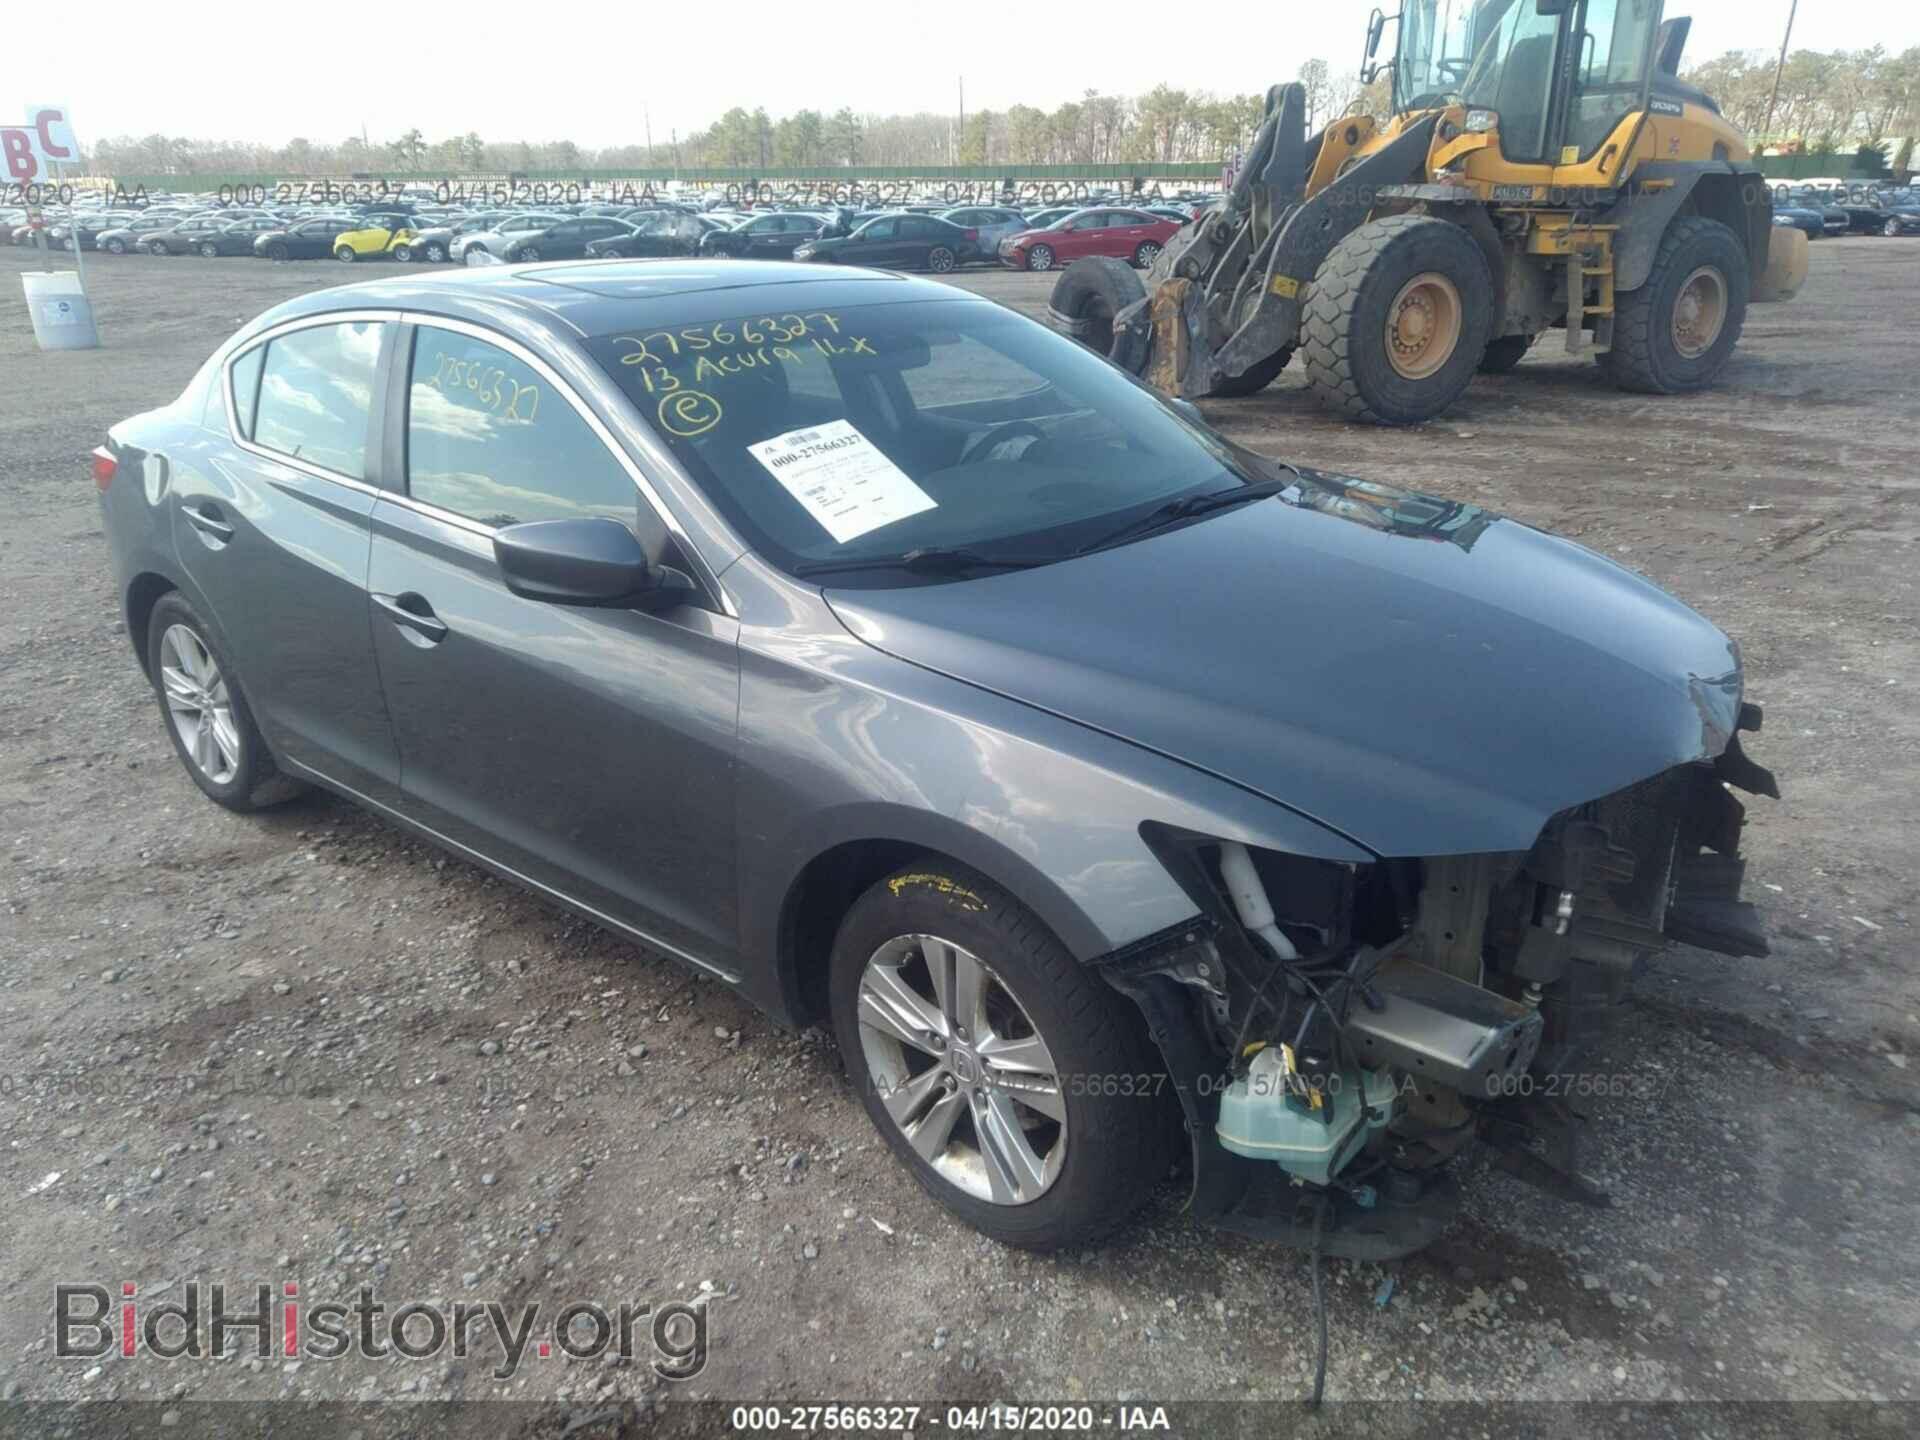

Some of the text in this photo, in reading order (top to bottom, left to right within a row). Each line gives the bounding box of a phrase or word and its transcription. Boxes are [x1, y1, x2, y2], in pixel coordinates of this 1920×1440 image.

[2, 130, 38, 178] B
[36, 110, 70, 157] C
[612, 312, 840, 365] 27566327
[641, 366, 680, 392] 13
[771, 434, 862, 468] 000-27566327
